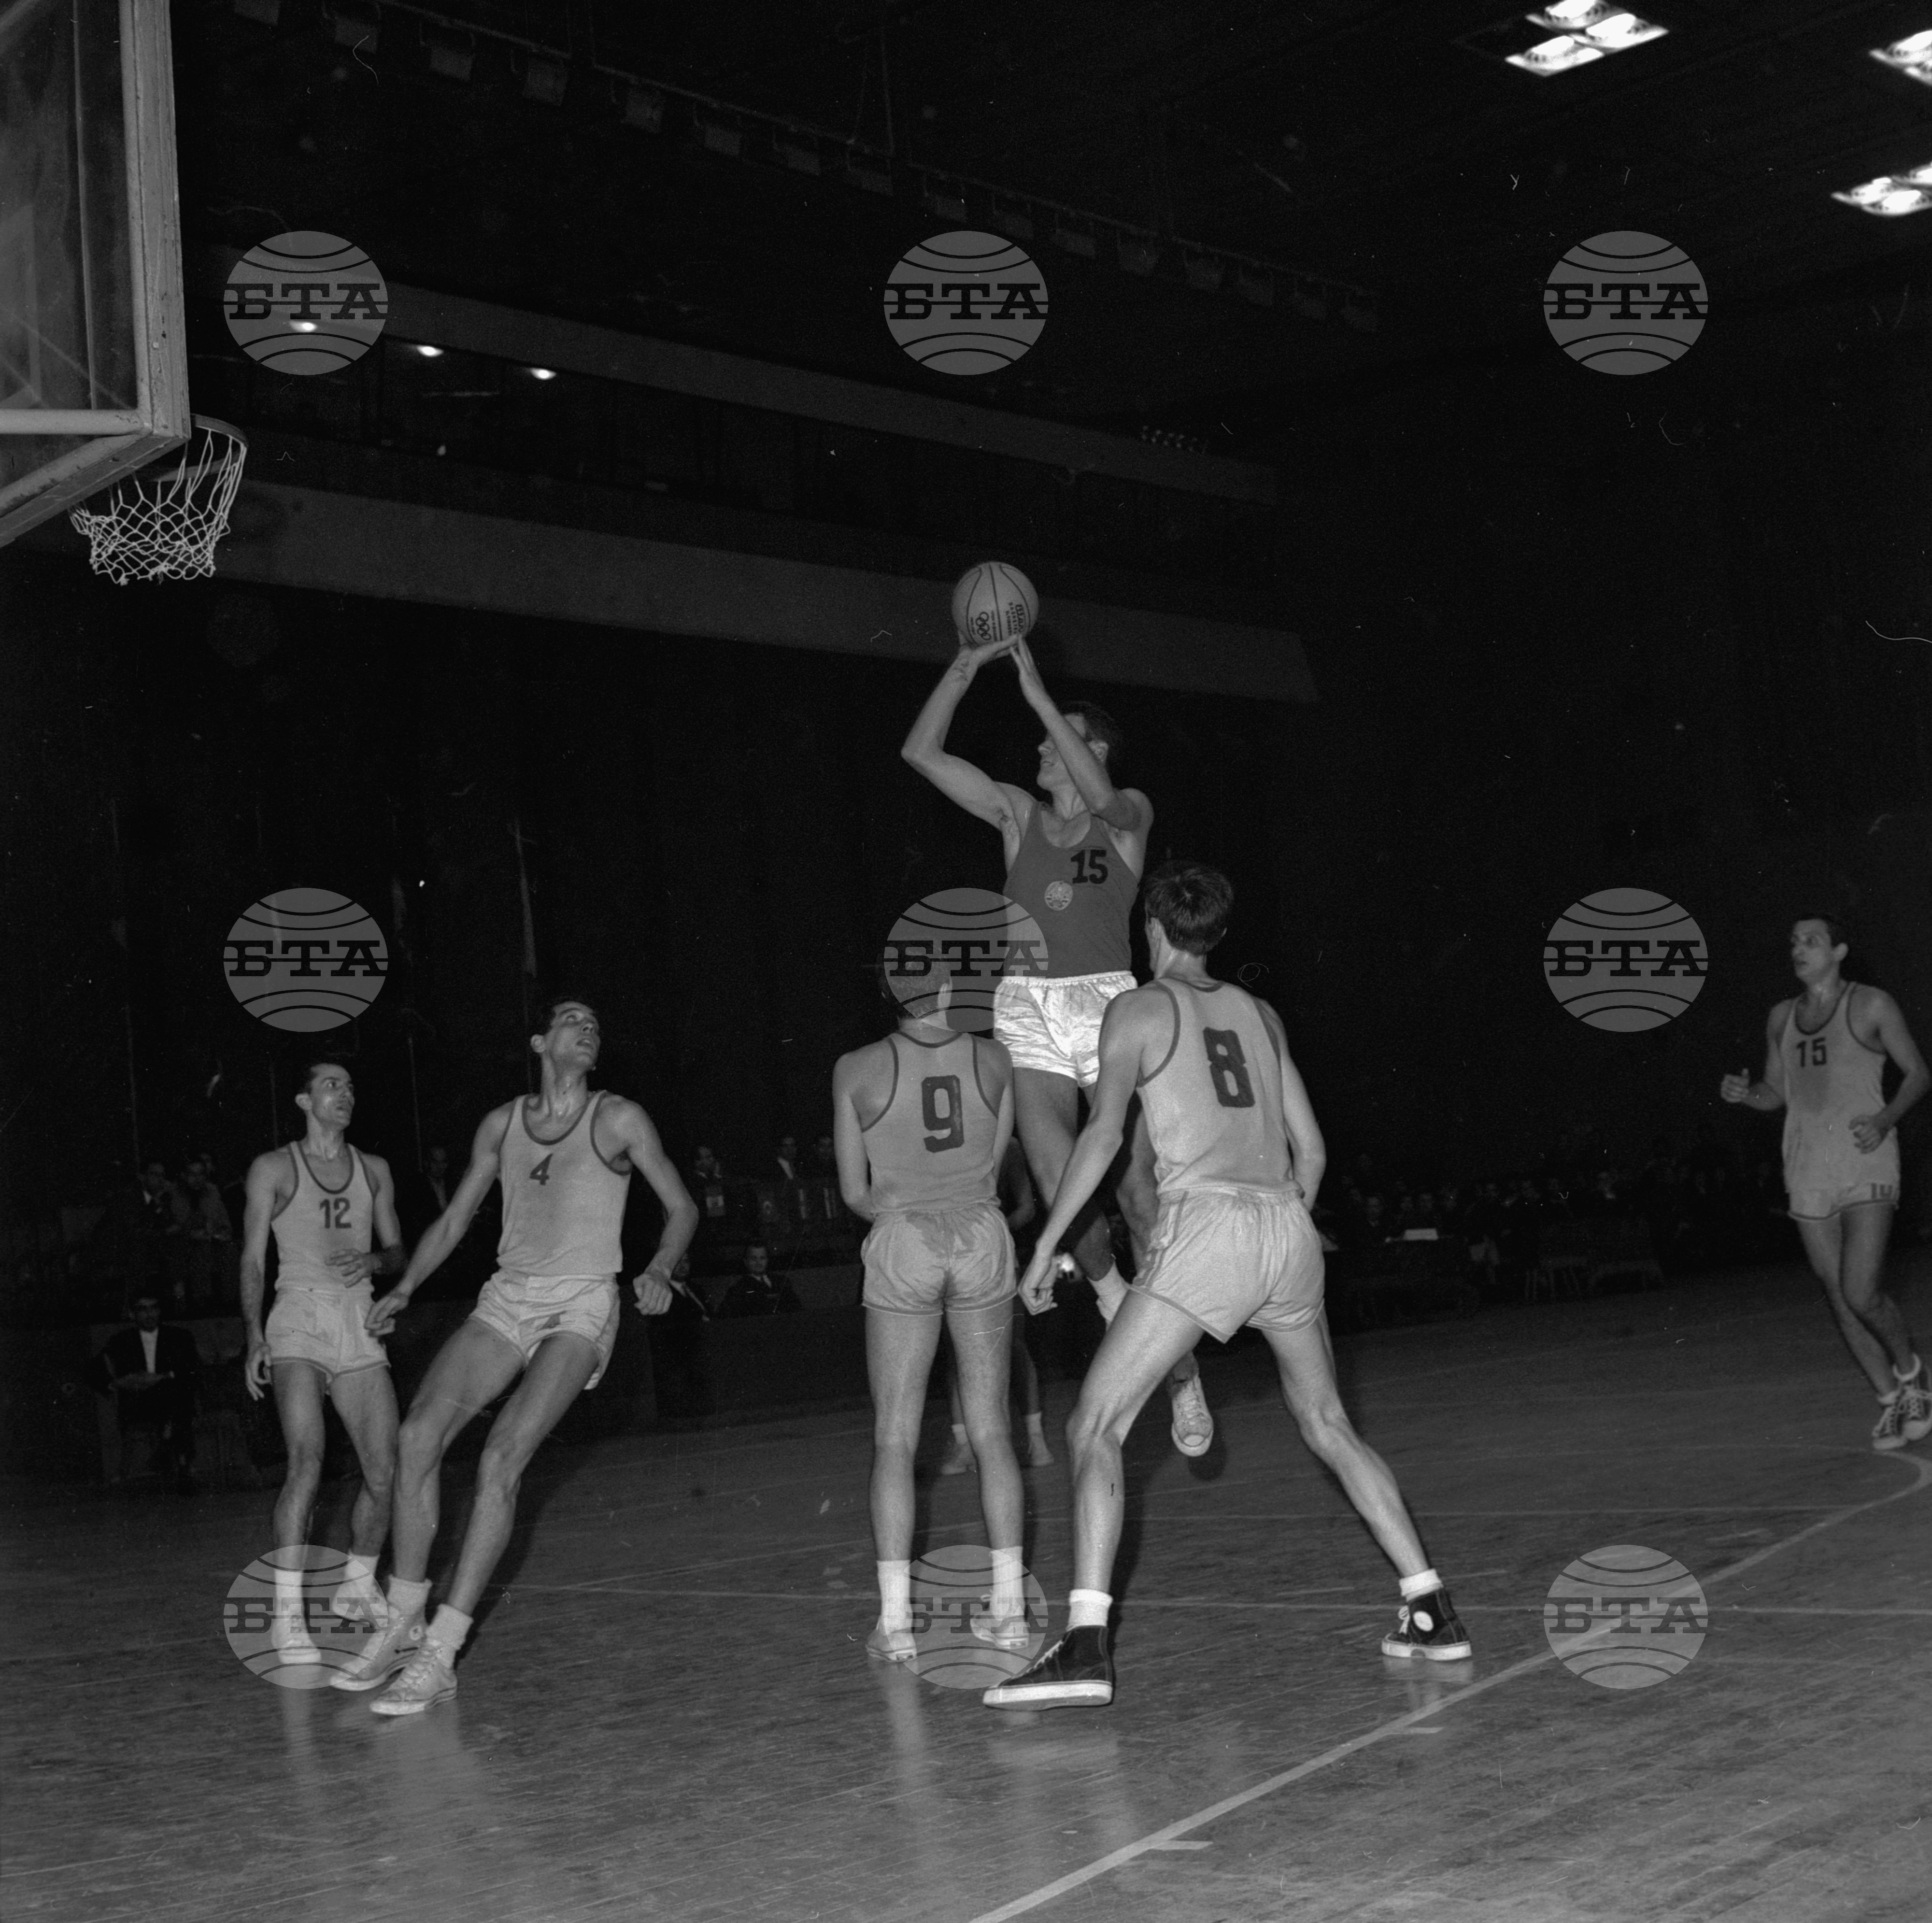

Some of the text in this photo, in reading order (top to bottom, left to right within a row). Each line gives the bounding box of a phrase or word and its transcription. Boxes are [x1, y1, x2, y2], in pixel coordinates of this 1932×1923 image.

[1070, 849, 1108, 884] 15
[1203, 1027, 1255, 1108] 8
[1796, 1037, 1826, 1068] 15
[922, 1075, 965, 1153] 9
[529, 1153, 554, 1186] 4
[320, 1197, 352, 1229] 12
